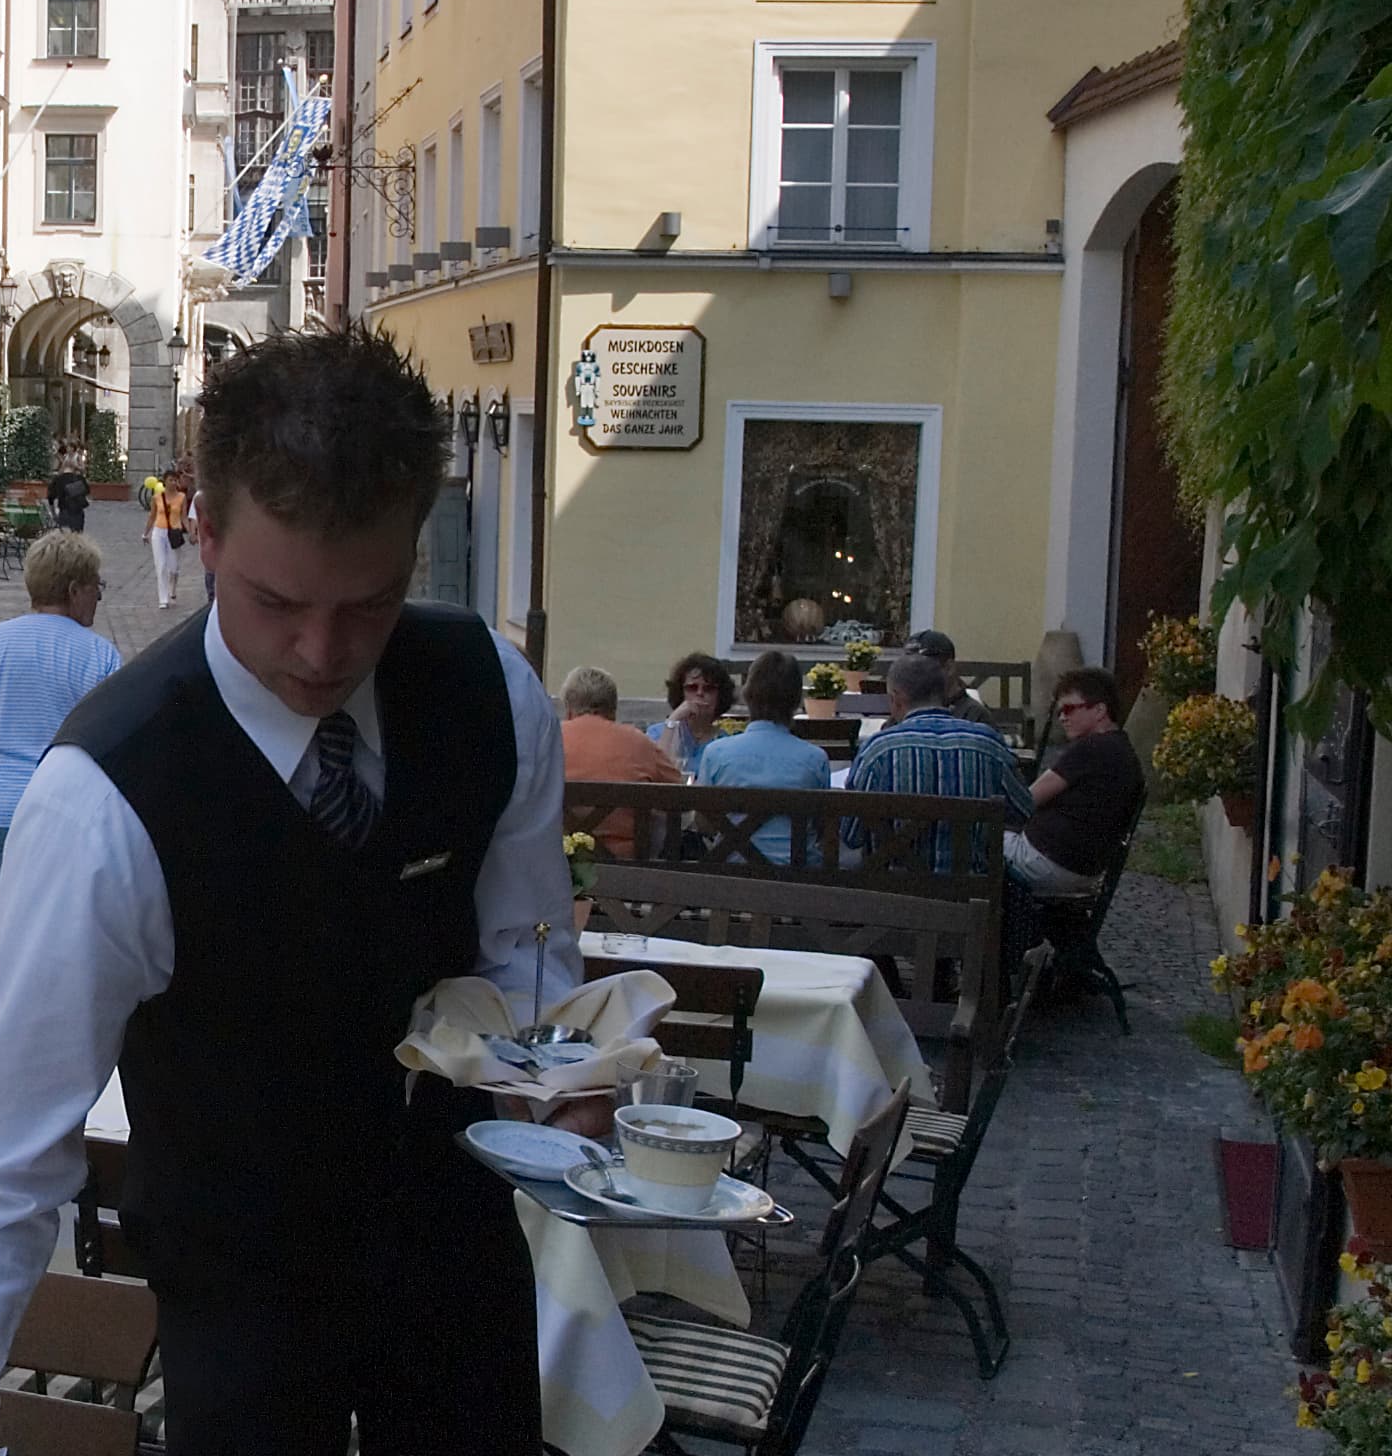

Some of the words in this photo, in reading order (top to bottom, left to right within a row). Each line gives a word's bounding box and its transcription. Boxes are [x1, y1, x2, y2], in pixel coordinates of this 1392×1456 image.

[608, 340, 684, 353] MUSIKDOSEN
[612, 362, 679, 375] GESCHENKE
[612, 384, 677, 398] SOUVENIRS
[610, 409, 678, 420] WEIHNACHTEN
[603, 424, 621, 434] DAS
[624, 424, 656, 434] GANZE
[659, 424, 684, 435] JAHR
